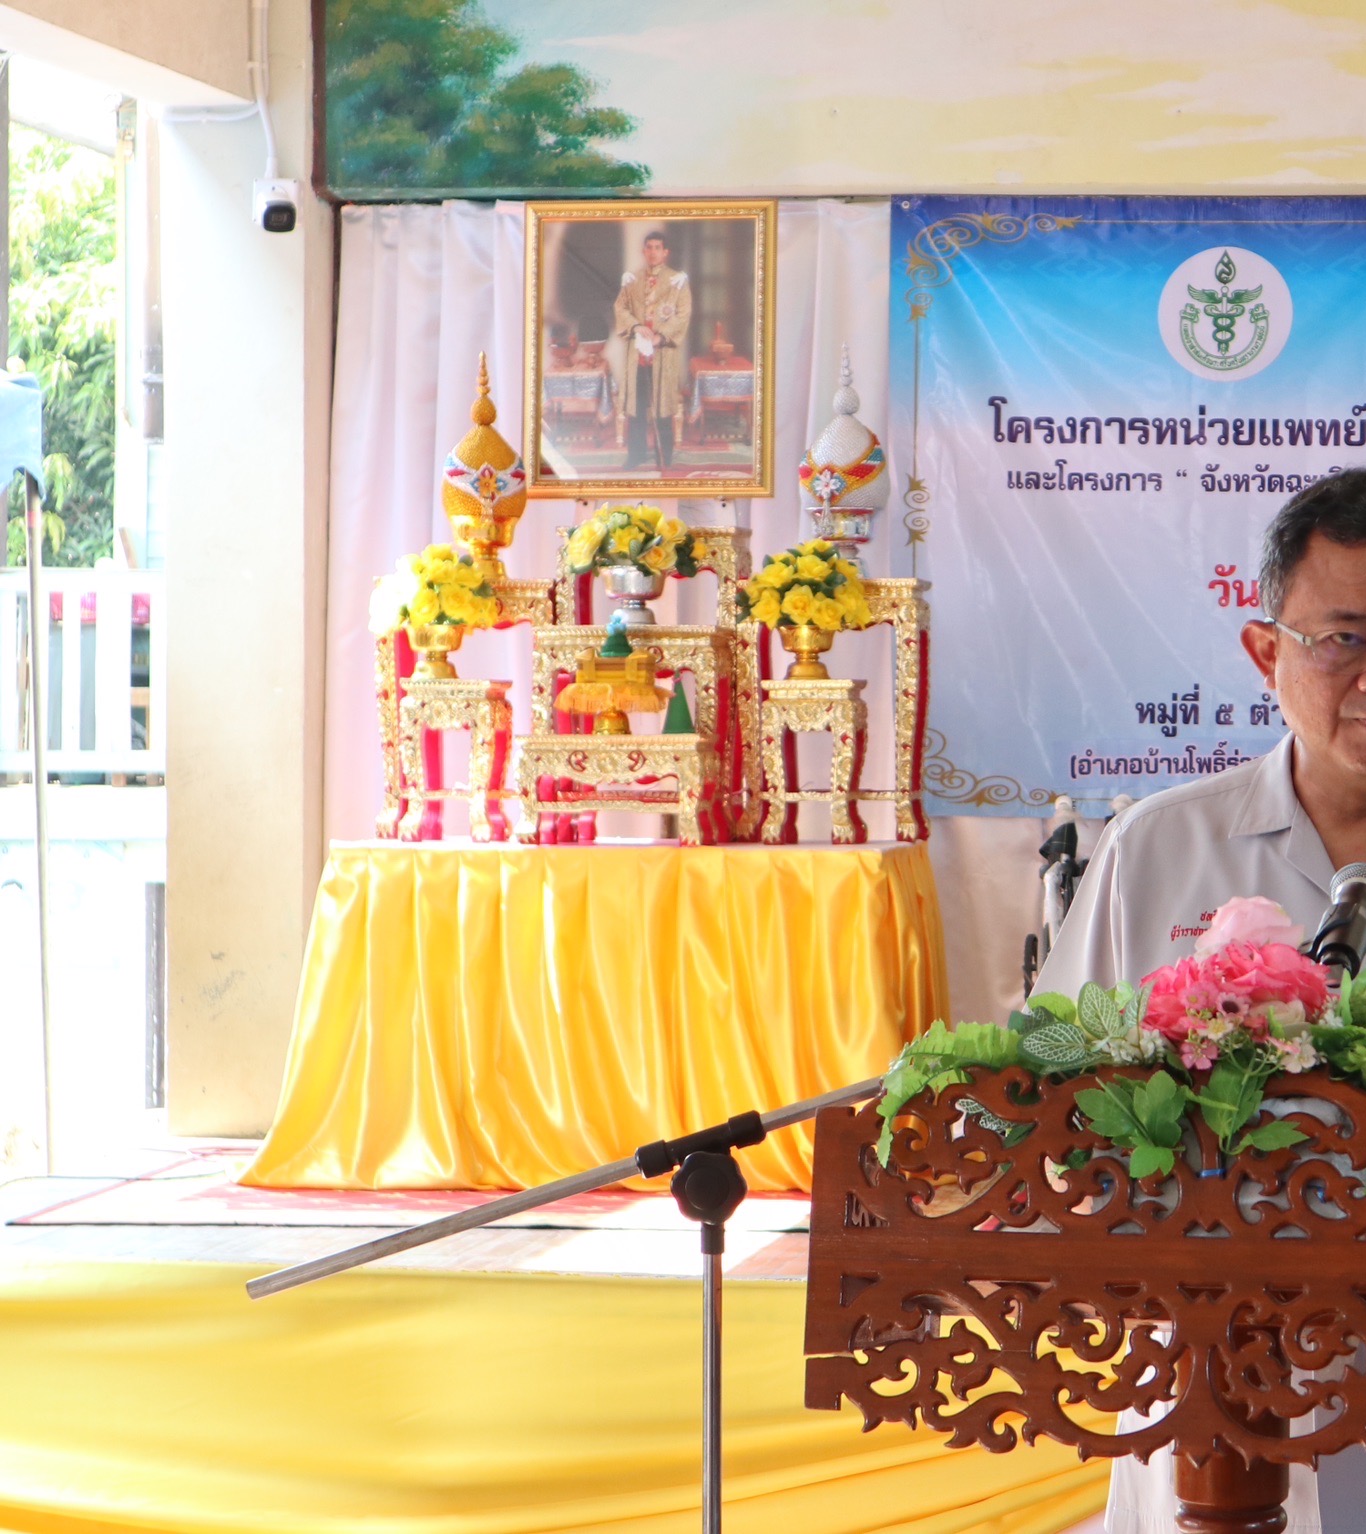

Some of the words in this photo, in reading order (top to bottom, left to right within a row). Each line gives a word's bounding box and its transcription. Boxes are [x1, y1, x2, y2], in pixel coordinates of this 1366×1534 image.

[1006, 459, 1163, 493] และโครงการ
[1208, 564, 1260, 608] วัน
[1135, 683, 1201, 738] หมู่ที่
[1215, 703, 1234, 726] ๕
